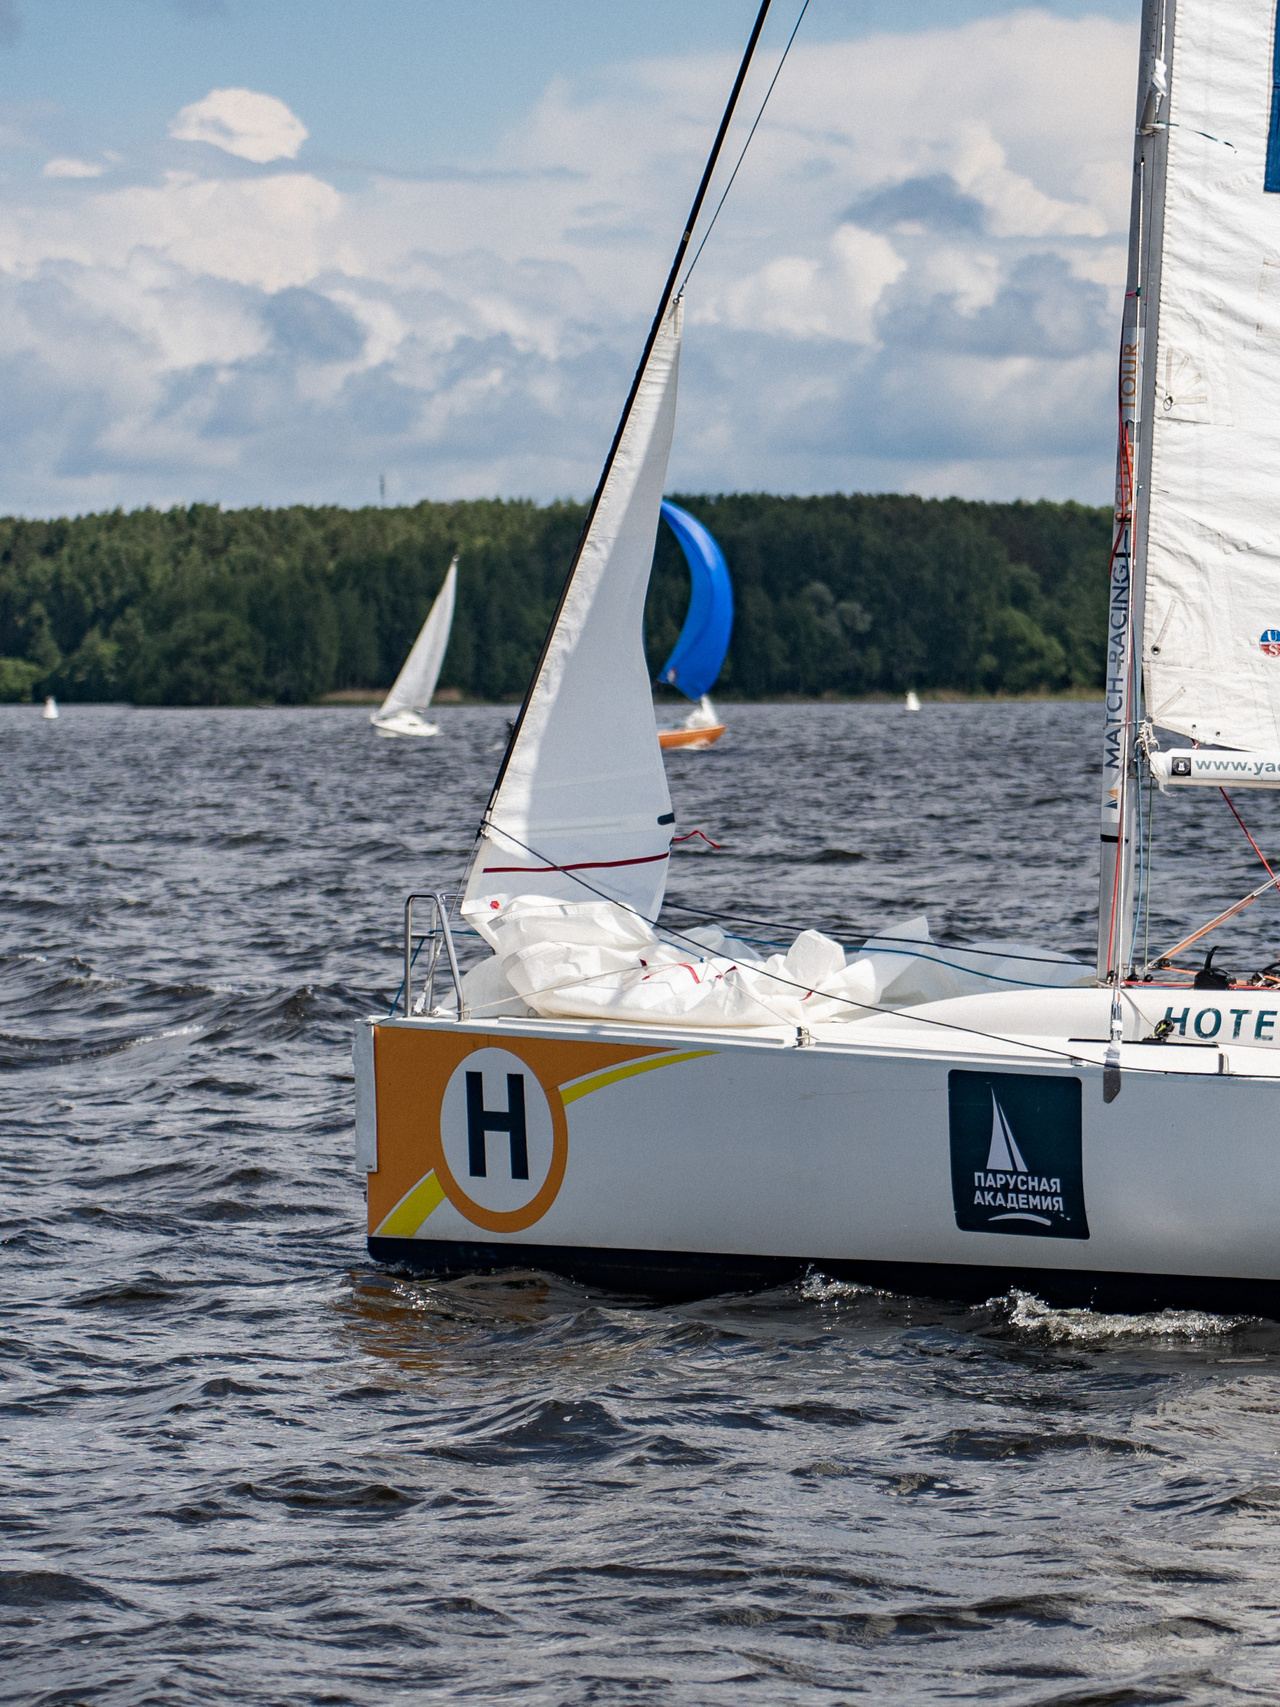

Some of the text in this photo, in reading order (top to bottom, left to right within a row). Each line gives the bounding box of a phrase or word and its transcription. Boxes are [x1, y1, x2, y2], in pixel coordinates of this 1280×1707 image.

[1121, 341, 1140, 408] TOUR
[1108, 564, 1130, 663] RACING
[1105, 676, 1124, 769] MATCH
[465, 1071, 529, 1181] H
[973, 1171, 1061, 1193] ПАРУСНАЯ
[973, 1190, 1065, 1212] АКАДЕМИЯ
